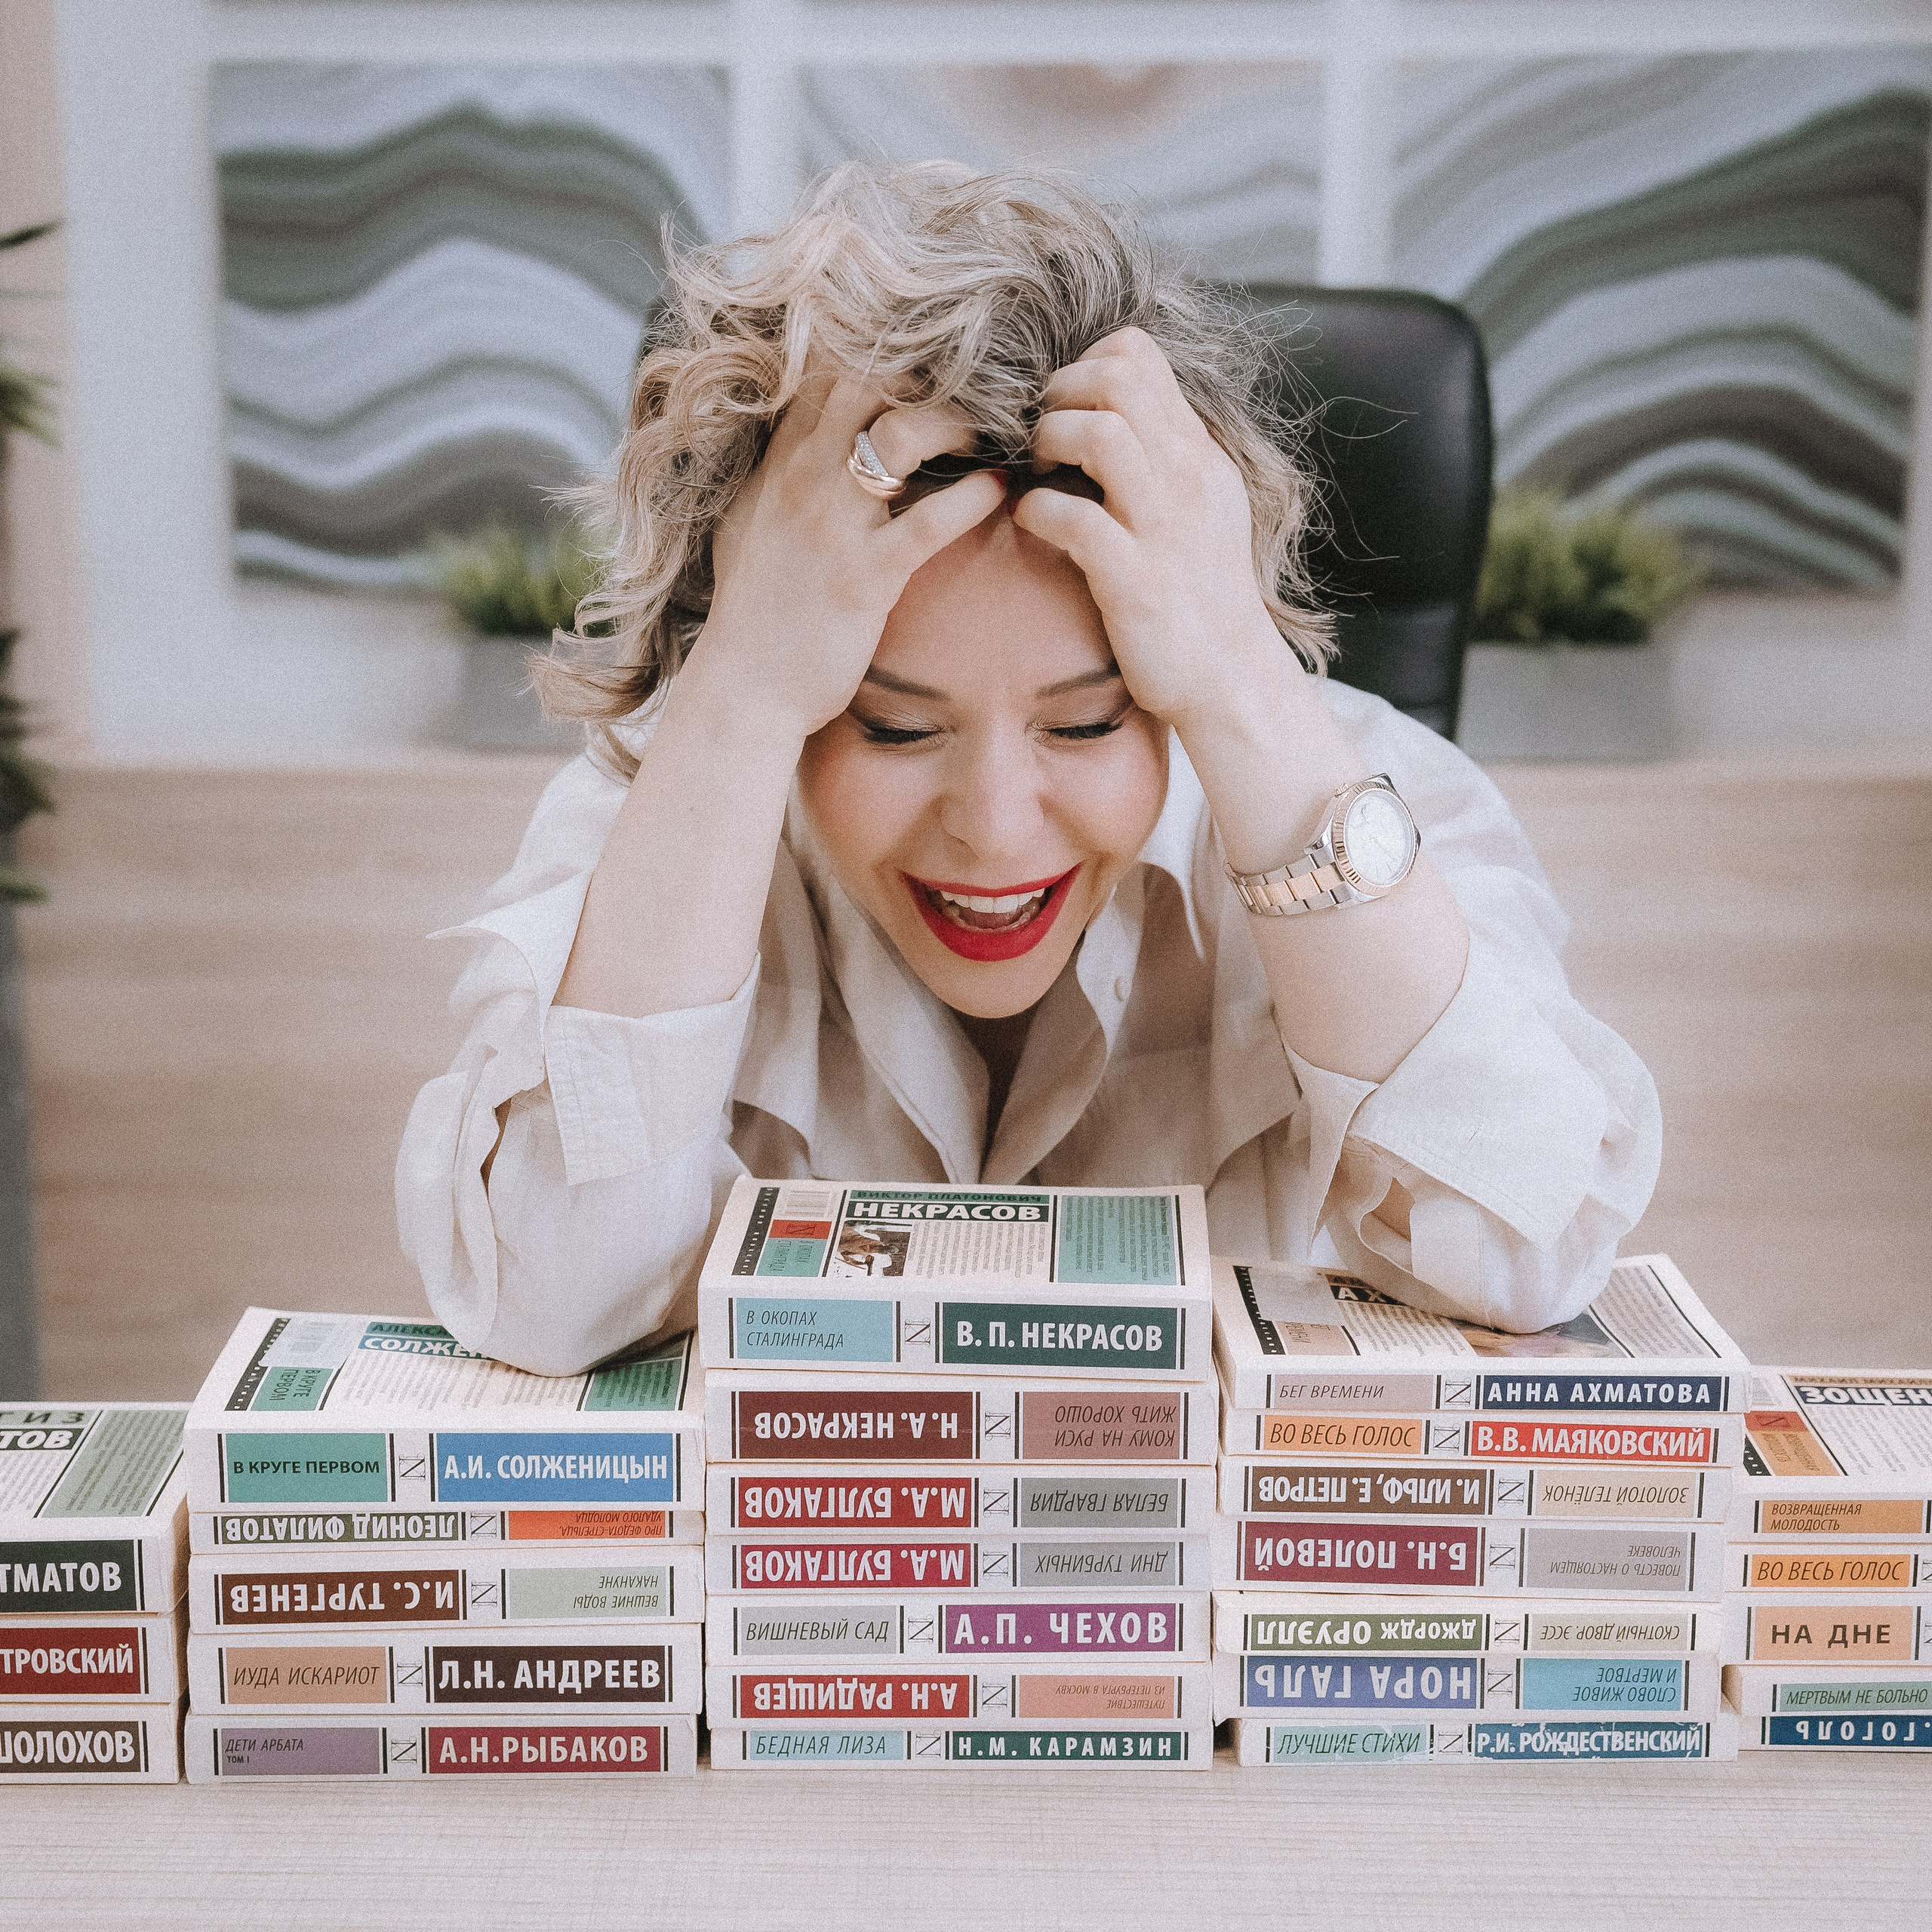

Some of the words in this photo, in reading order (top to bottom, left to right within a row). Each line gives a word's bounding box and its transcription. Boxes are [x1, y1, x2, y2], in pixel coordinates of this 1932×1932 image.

[854, 1202, 1041, 1220] НЕКРАСОВ
[746, 1310, 755, 1324] В
[761, 1311, 817, 1325] ОКОПАХ
[747, 1332, 843, 1349] СТАЛИНГРАДА
[957, 1321, 981, 1346] В.
[989, 1321, 1015, 1347] П.
[1022, 1322, 1163, 1351] НЕКРАСОВ
[365, 1338, 483, 1358] СОЛЖЕ
[269, 1369, 299, 1401] ПЕРВОМ
[293, 1375, 318, 1397] КРУГЕ
[1280, 1385, 1307, 1398] БЕГ
[1311, 1385, 1384, 1398] ВРЕМЕНИ
[1487, 1383, 1559, 1402] АННА
[1570, 1383, 1711, 1404] АХМАТОВА
[1055, 1406, 1125, 1423] ХОРОШО
[1132, 1406, 1176, 1423] ЖИТЬ
[755, 1413, 894, 1438] НЕКРАСОВ
[900, 1413, 926, 1438] А.
[931, 1412, 958, 1438] Н.
[1270, 1423, 1296, 1444] ВО
[1301, 1424, 1346, 1445] ВЕСЬ
[1352, 1426, 1416, 1447] ГОЛОС
[1054, 1429, 1094, 1447] РУСИ
[1103, 1429, 1121, 1446] НА
[1128, 1429, 1175, 1447] КОМУ
[1478, 1426, 1526, 1453] В.В.
[1532, 1427, 1705, 1457] МАЯКОВСКИЙ
[233, 1461, 244, 1473] В
[249, 1461, 300, 1474] КРУГЕ
[306, 1461, 380, 1473] ПЕРВОМ
[445, 1455, 491, 1479] А.И.
[497, 1455, 667, 1484] СОЛЖЕНИЦЫН
[1258, 1475, 1346, 1503] ПЕТРОВ
[1352, 1477, 1371, 1503] Е.
[1376, 1474, 1451, 1505] ИЛЬФ,
[1457, 1478, 1480, 1504] И.
[1543, 1485, 1611, 1505] ТЕЛЁНОК
[1617, 1487, 1689, 1506] ЗОЛОТОЙ
[744, 1487, 891, 1518] БУЛГАКОВ
[901, 1487, 965, 1518] М.А.
[1030, 1491, 1107, 1512] ГВАРДИЯ
[1113, 1493, 1169, 1512] БЕЛАЯ
[1771, 1503, 1862, 1517] ВОЗВРАЩЕННАЯ
[352, 1513, 454, 1539] ЛЕОНИД
[576, 1512, 620, 1523] МОЛОДЦА
[623, 1512, 662, 1522] УДАЛОГО
[1770, 1518, 1840, 1531] МОЛОДОСТЬ
[226, 1515, 345, 1541] ФИЛАТОВ
[559, 1525, 641, 1537] ФЕДОТА-СТРЕЛЬЦА,
[645, 1526, 662, 1536] ПРО
[1131, 1551, 1168, 1572] ДНИ
[1255, 1537, 1396, 1571] ПОЛЕВОЙ
[1407, 1541, 1466, 1571] Б.Н.
[1627, 1545, 1681, 1558] ЧЕЛОВЕКЕ
[745, 1550, 891, 1582] БУЛГАКОВ
[900, 1549, 964, 1581] М.А.
[1035, 1554, 1122, 1574] ТУРБИНЫХ
[1550, 1561, 1617, 1575] НАСТОЯЩЕМ
[1621, 1564, 1629, 1575] О
[1634, 1564, 1681, 1576] ПОВЕСТЬ
[1757, 1561, 1783, 1580] ВО
[1788, 1561, 1834, 1580] ВЕСЬ
[1839, 1561, 1904, 1580] ГОЛОС
[598, 1575, 658, 1589] НАКАНУНЕ
[230, 1582, 385, 1613] ТУРГЕНЕВ
[393, 1581, 453, 1609] И.С.
[573, 1595, 607, 1608] ВОДЫ
[611, 1595, 659, 1607] ВЕШНИЕ
[746, 1618, 849, 1641] ВИШНЕВЫЙ
[854, 1621, 889, 1642] САД
[953, 1613, 1032, 1644] А.П.
[1049, 1612, 1168, 1644] ЧЕХОВ
[1257, 1620, 1372, 1644] ОРУЭЛЛ
[1381, 1618, 1476, 1639] ДЖОРДЖ
[1540, 1626, 1571, 1640] ЭССЕ
[1577, 1623, 1615, 1640] ДВОР.
[1616, 1626, 1680, 1642] СКОТНЫЙ
[1771, 1624, 1813, 1644] НА
[1828, 1624, 1890, 1648] ДНЕ
[0, 1643, 134, 1674] ТРОВСКИЙ
[233, 1666, 280, 1688] ИУДА
[288, 1666, 380, 1685] ИСКАРИОТ
[438, 1660, 506, 1689] Л.Н.
[514, 1660, 660, 1694] АНДРЕЕВ
[1255, 1664, 1352, 1698] ГАЛЬ
[1369, 1666, 1471, 1700] НОРА
[1596, 1667, 1662, 1682] МЕРТВОЕ
[1667, 1668, 1677, 1682] И
[754, 1678, 893, 1710] РАДИЩЕВ
[901, 1682, 958, 1710] А.Н.
[1056, 1685, 1091, 1695] МОСКВУ
[1093, 1685, 1099, 1694] В
[1102, 1685, 1152, 1694] ПЕТЕРБУРГА
[1154, 1685, 1165, 1694] ИЗ
[1573, 1686, 1623, 1701] ЖИВОЕ
[1627, 1687, 1676, 1702] СЛОВО
[1786, 1690, 1851, 1705] МЕРТВЫМ
[1855, 1690, 1875, 1704] НЕ
[1876, 1688, 1928, 1704] БОЛЬНО
[1106, 1700, 1165, 1709] ПУТЕШЕСТВИЕ
[1477, 1733, 1515, 1753] Р.И.
[1519, 1724, 1700, 1755] РОЖДЕСТВЕНСКИЙ
[1796, 1721, 1915, 1740] ГОГОЛЬ
[225, 1738, 257, 1754] ДЕТИ
[260, 1738, 303, 1752] АРБАТА
[756, 1736, 829, 1757] БЕДНАЯ
[837, 1736, 886, 1755] ЛИЗА
[958, 1737, 1017, 1756] Н.М.
[1029, 1737, 1171, 1756] КАРАМЗИН
[1278, 1733, 1358, 1755] ЛУЧШИЕ
[1362, 1732, 1421, 1754] СТИХИ
